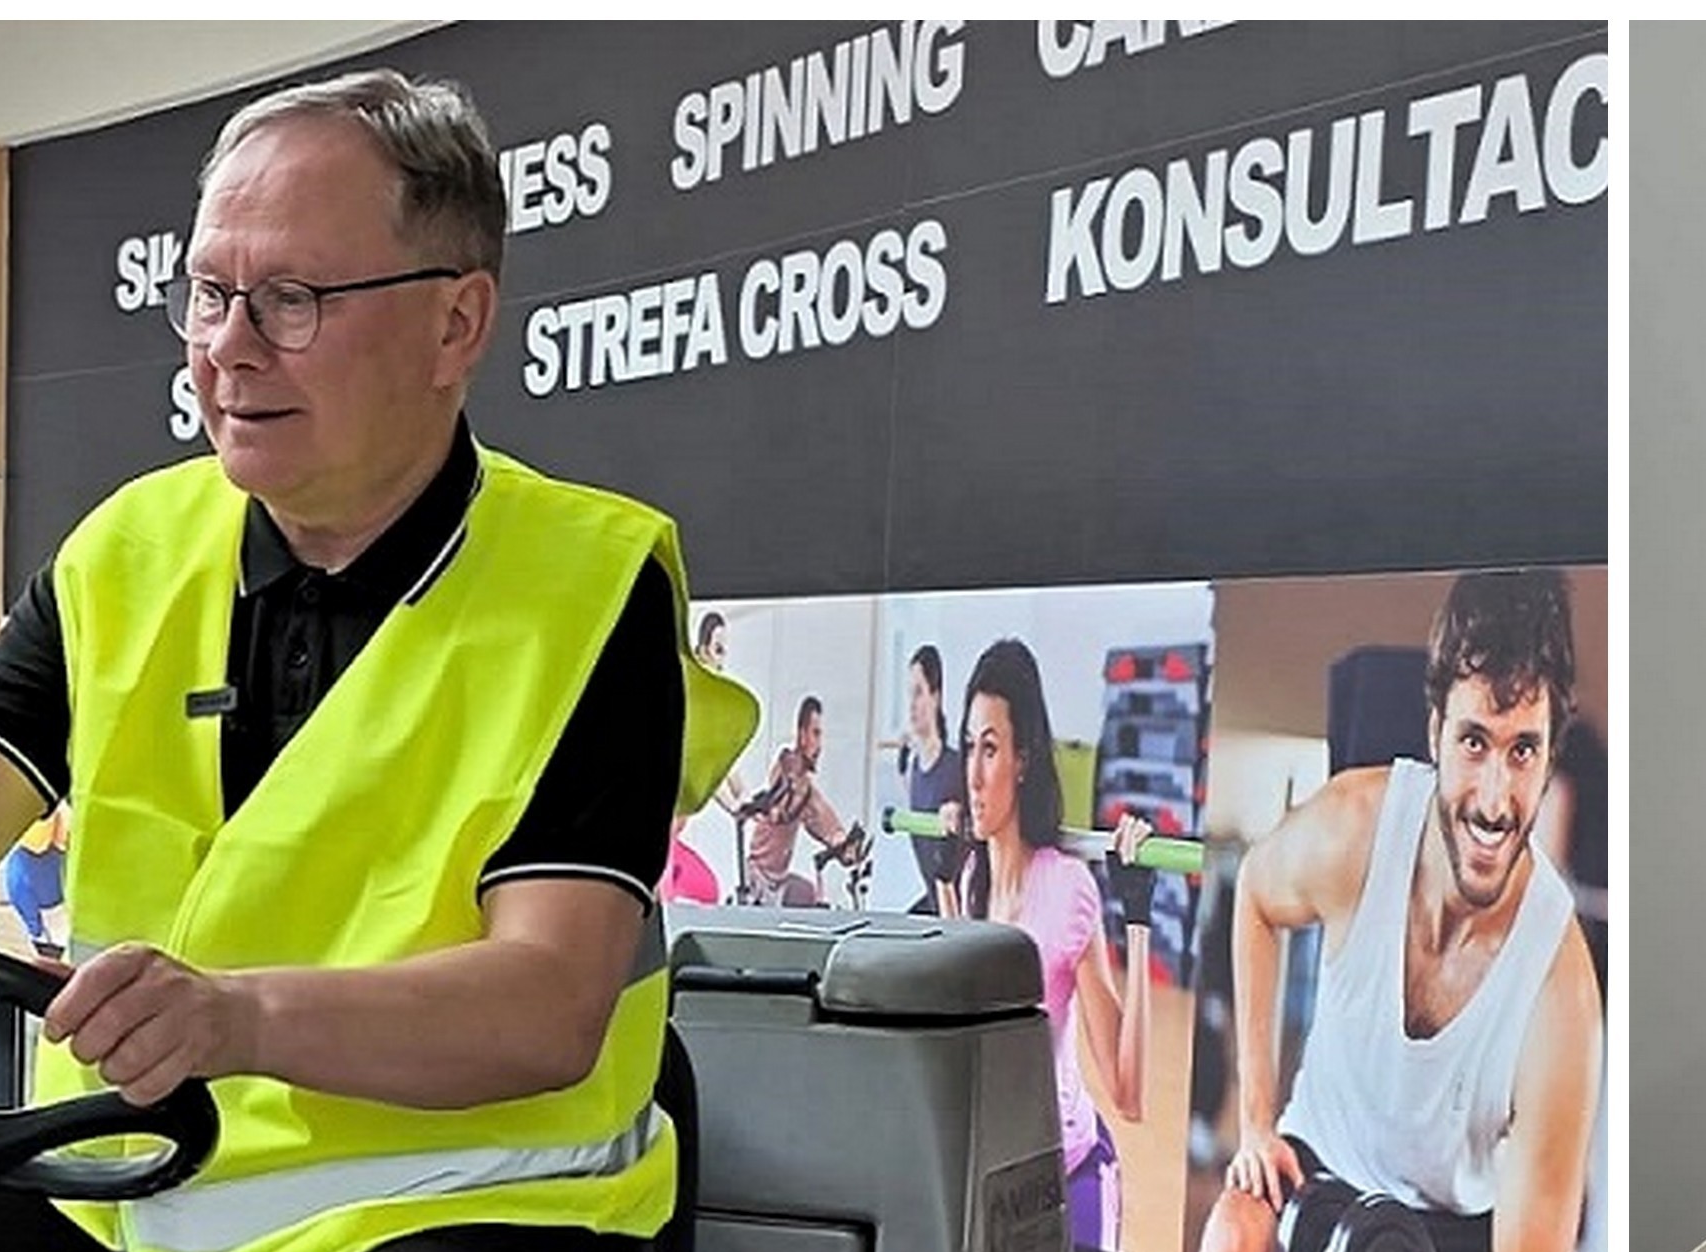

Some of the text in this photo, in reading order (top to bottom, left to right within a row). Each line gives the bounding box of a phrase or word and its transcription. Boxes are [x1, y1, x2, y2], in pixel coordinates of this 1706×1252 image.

[523, 53, 1608, 397] STREFA CROSS KONSULTAC
[671, 20, 966, 190] SPINNING
